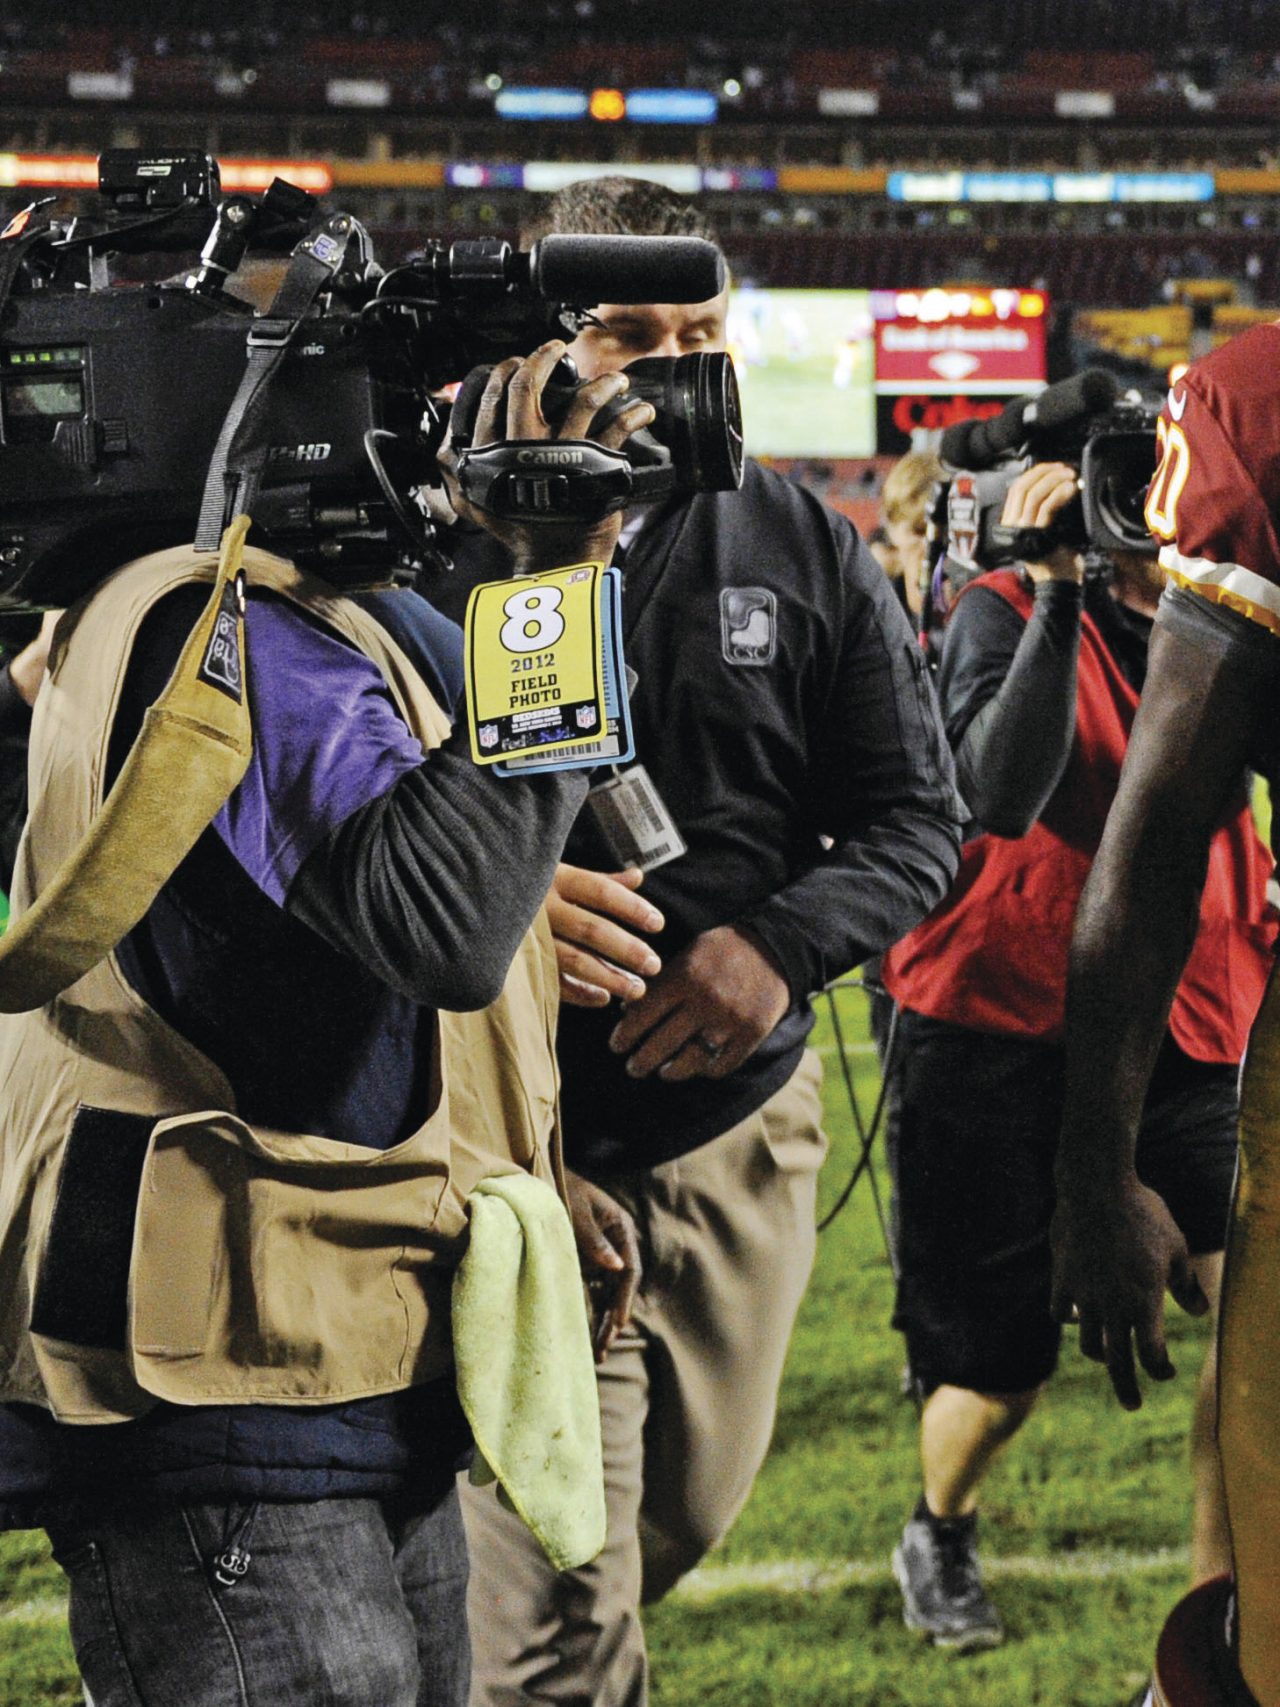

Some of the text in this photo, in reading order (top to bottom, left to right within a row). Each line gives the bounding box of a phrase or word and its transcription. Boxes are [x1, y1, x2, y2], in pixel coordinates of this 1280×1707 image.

[516, 450, 584, 465] Canon
[499, 585, 566, 654] 8
[511, 653, 555, 673] 2012
[511, 673, 558, 693] FIELD
[509, 688, 562, 709] PHOTO
